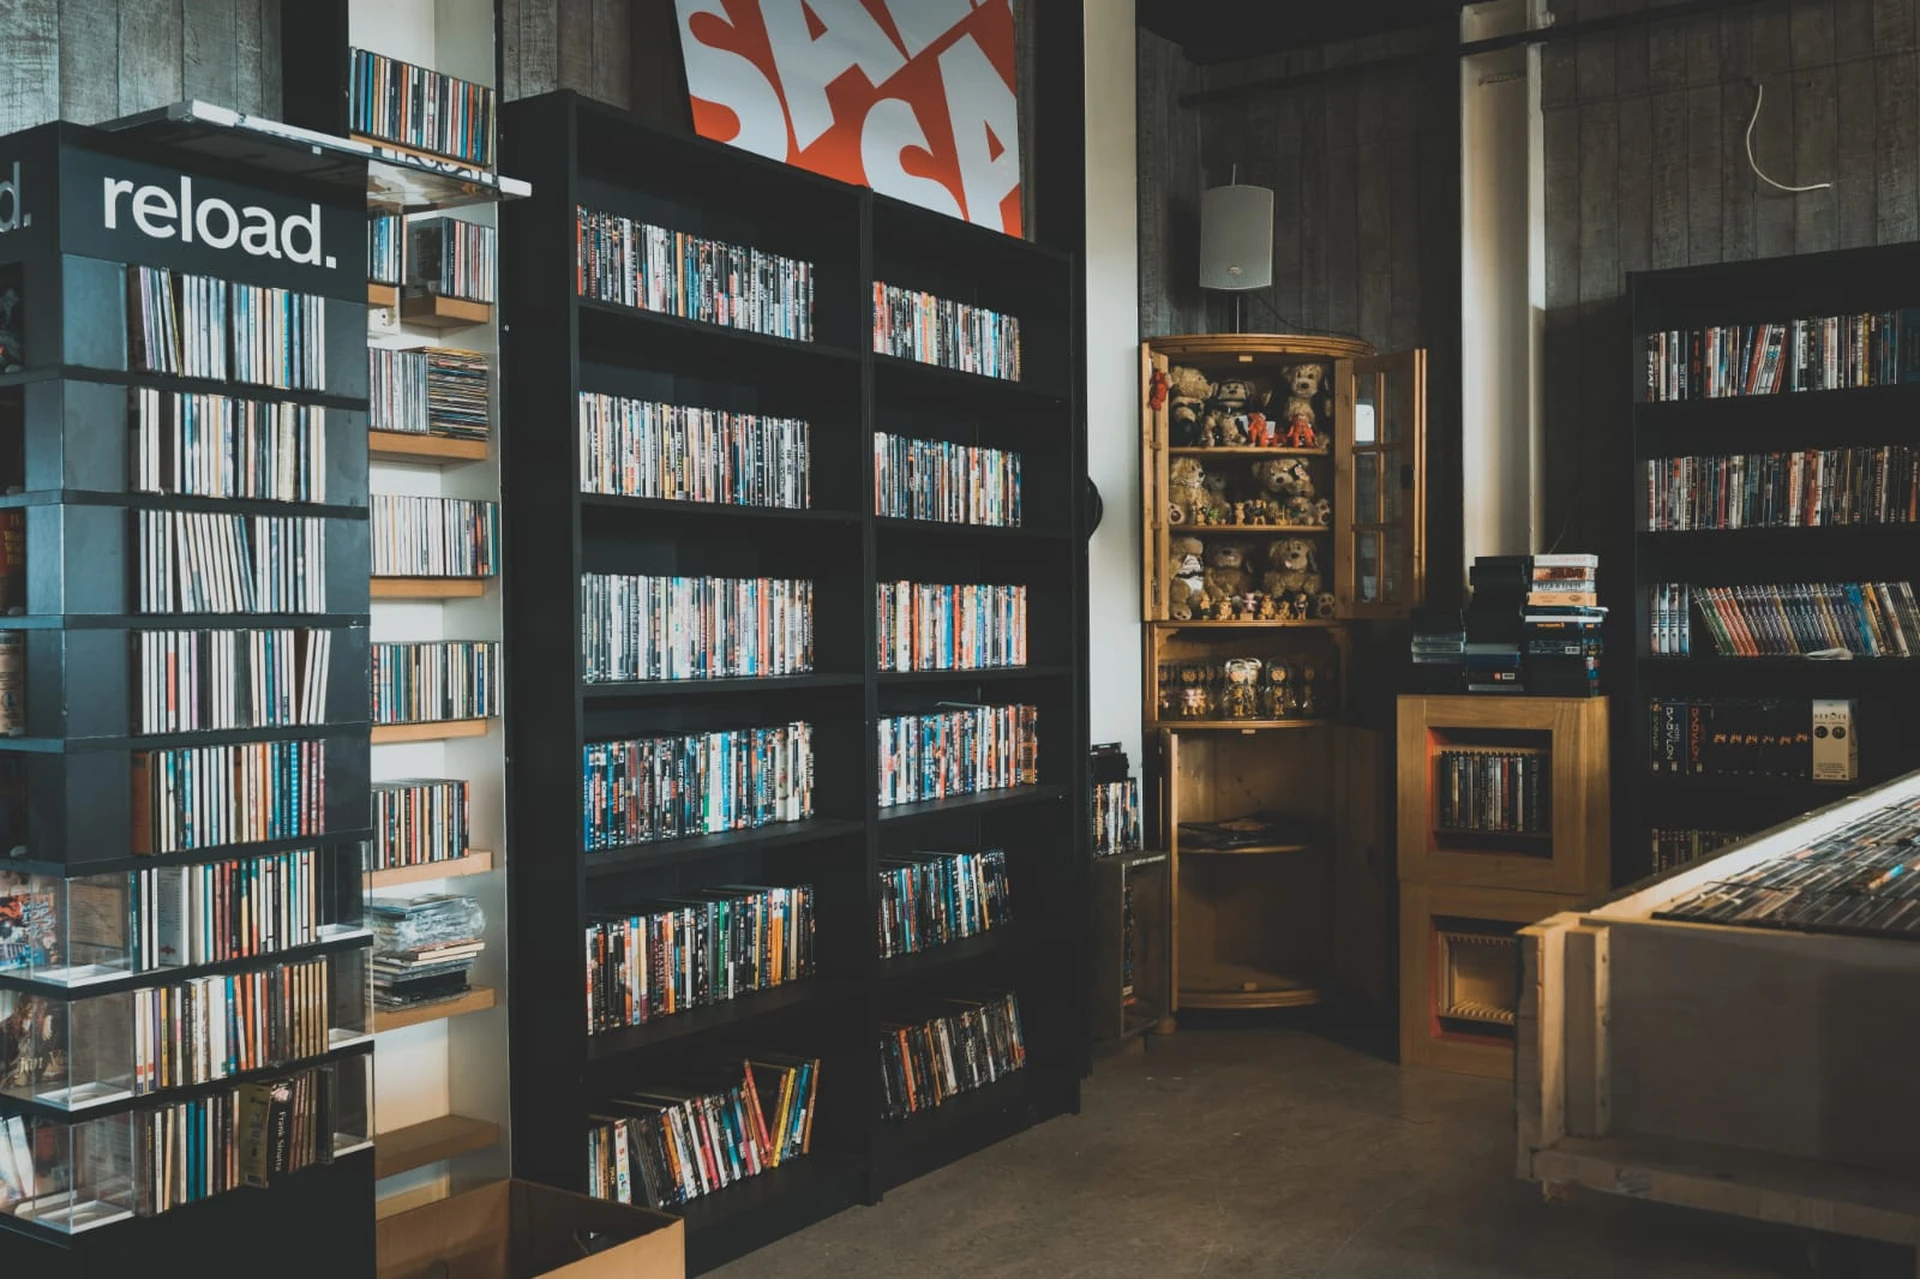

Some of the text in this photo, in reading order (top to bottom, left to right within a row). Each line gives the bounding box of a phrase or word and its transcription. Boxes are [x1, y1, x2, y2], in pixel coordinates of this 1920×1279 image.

[103, 175, 337, 269] reload.
[275, 1111, 287, 1172] Frank Sinatra
